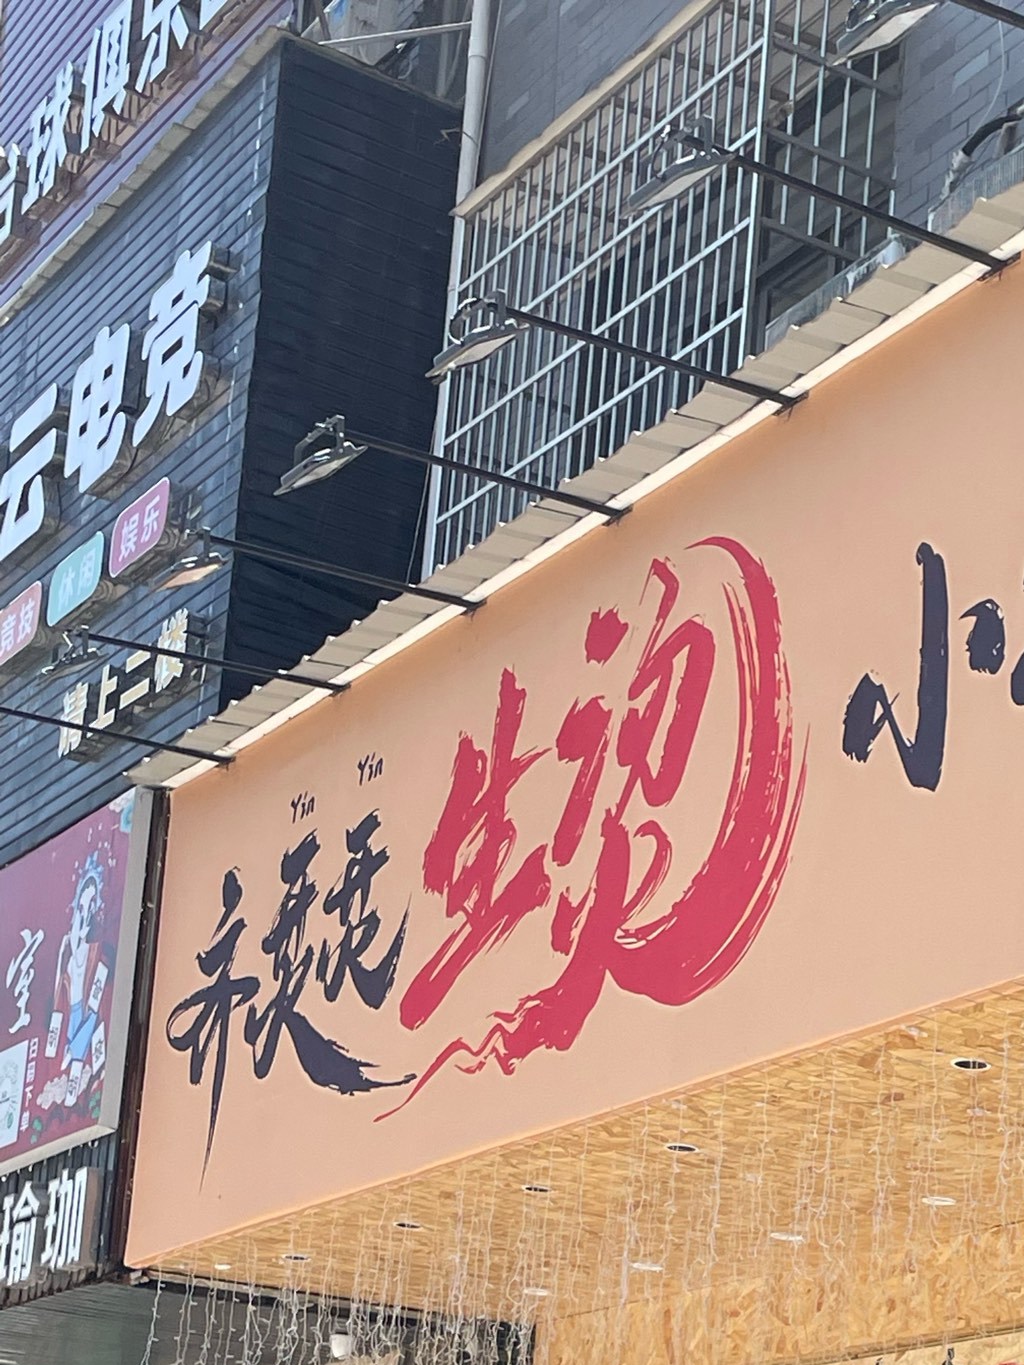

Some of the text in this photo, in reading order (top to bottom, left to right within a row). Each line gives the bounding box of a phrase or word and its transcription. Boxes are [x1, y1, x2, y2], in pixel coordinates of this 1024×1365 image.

[119, 494, 160, 562] 娱乐
[57, 548, 96, 612] 休闲
[6, 928, 45, 1034] 室
